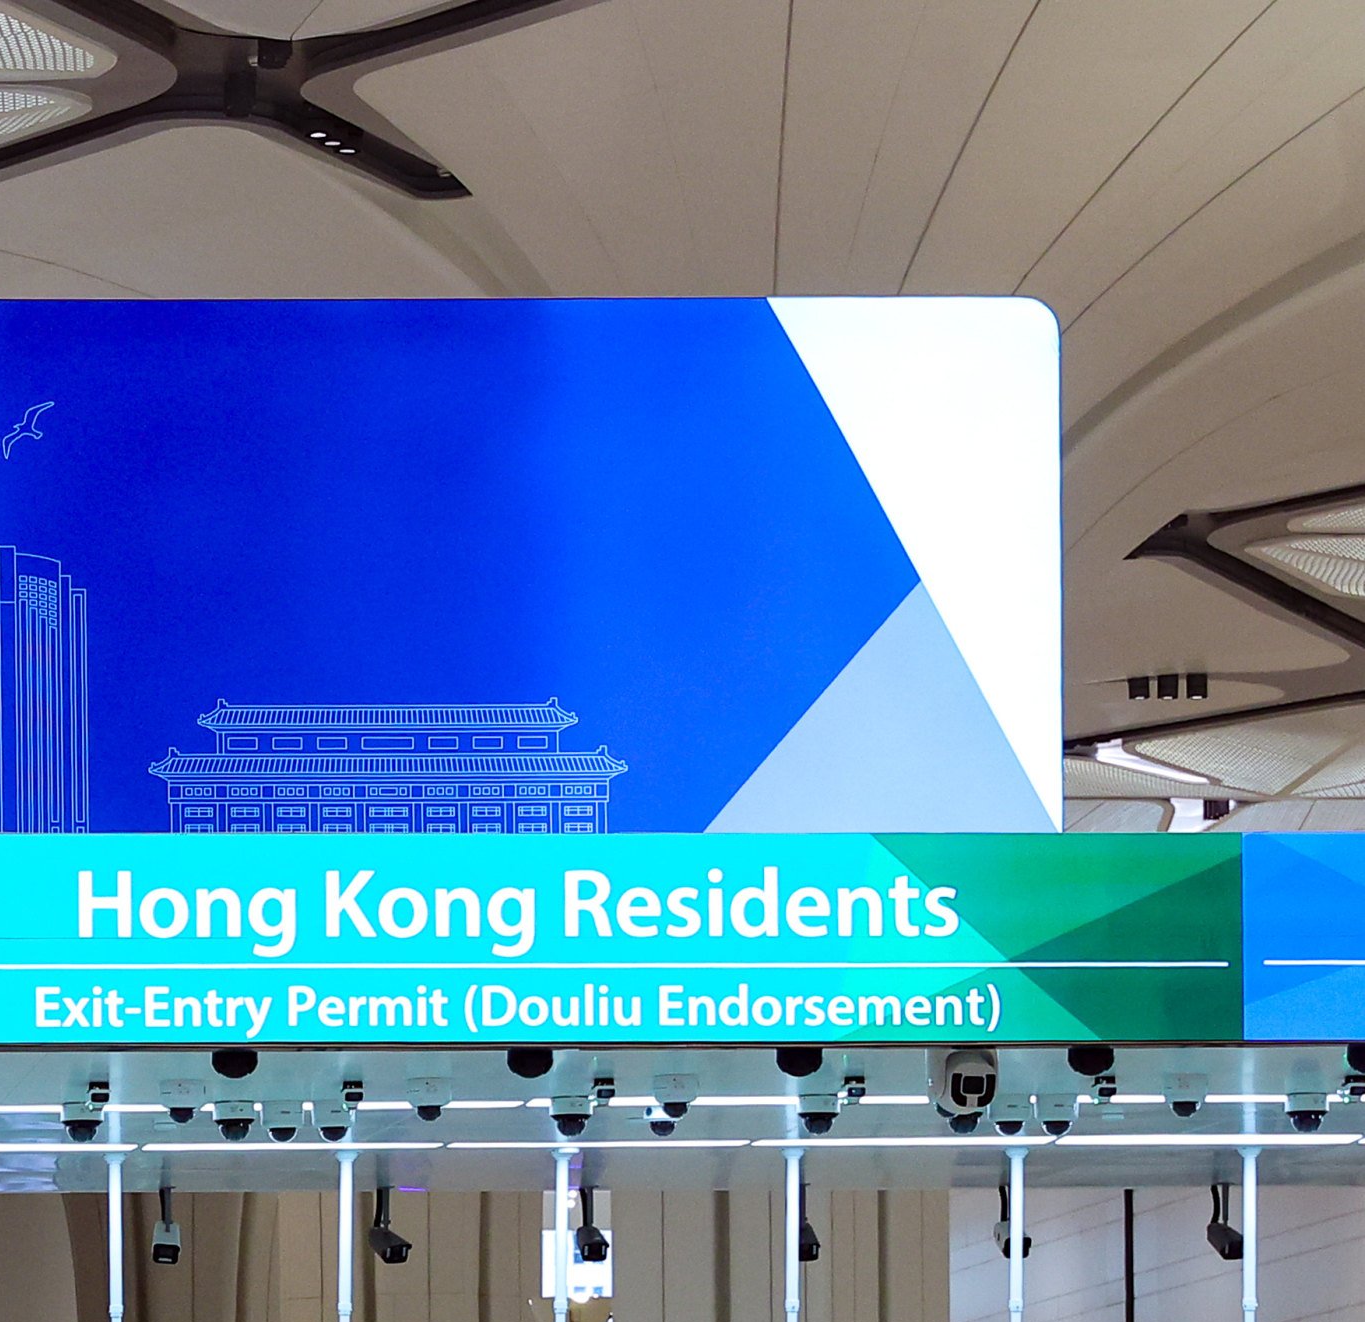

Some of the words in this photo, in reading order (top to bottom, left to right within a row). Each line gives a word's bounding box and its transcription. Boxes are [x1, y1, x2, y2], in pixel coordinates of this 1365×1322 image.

[77, 870, 297, 957] Hong
[325, 869, 536, 957] Kong
[564, 866, 959, 938] Residents
[35, 985, 272, 1038] Exit-Entry
[287, 985, 449, 1028] Permit
[464, 984, 642, 1033] (Douliu
[658, 983, 1001, 1032] Endorsement)
